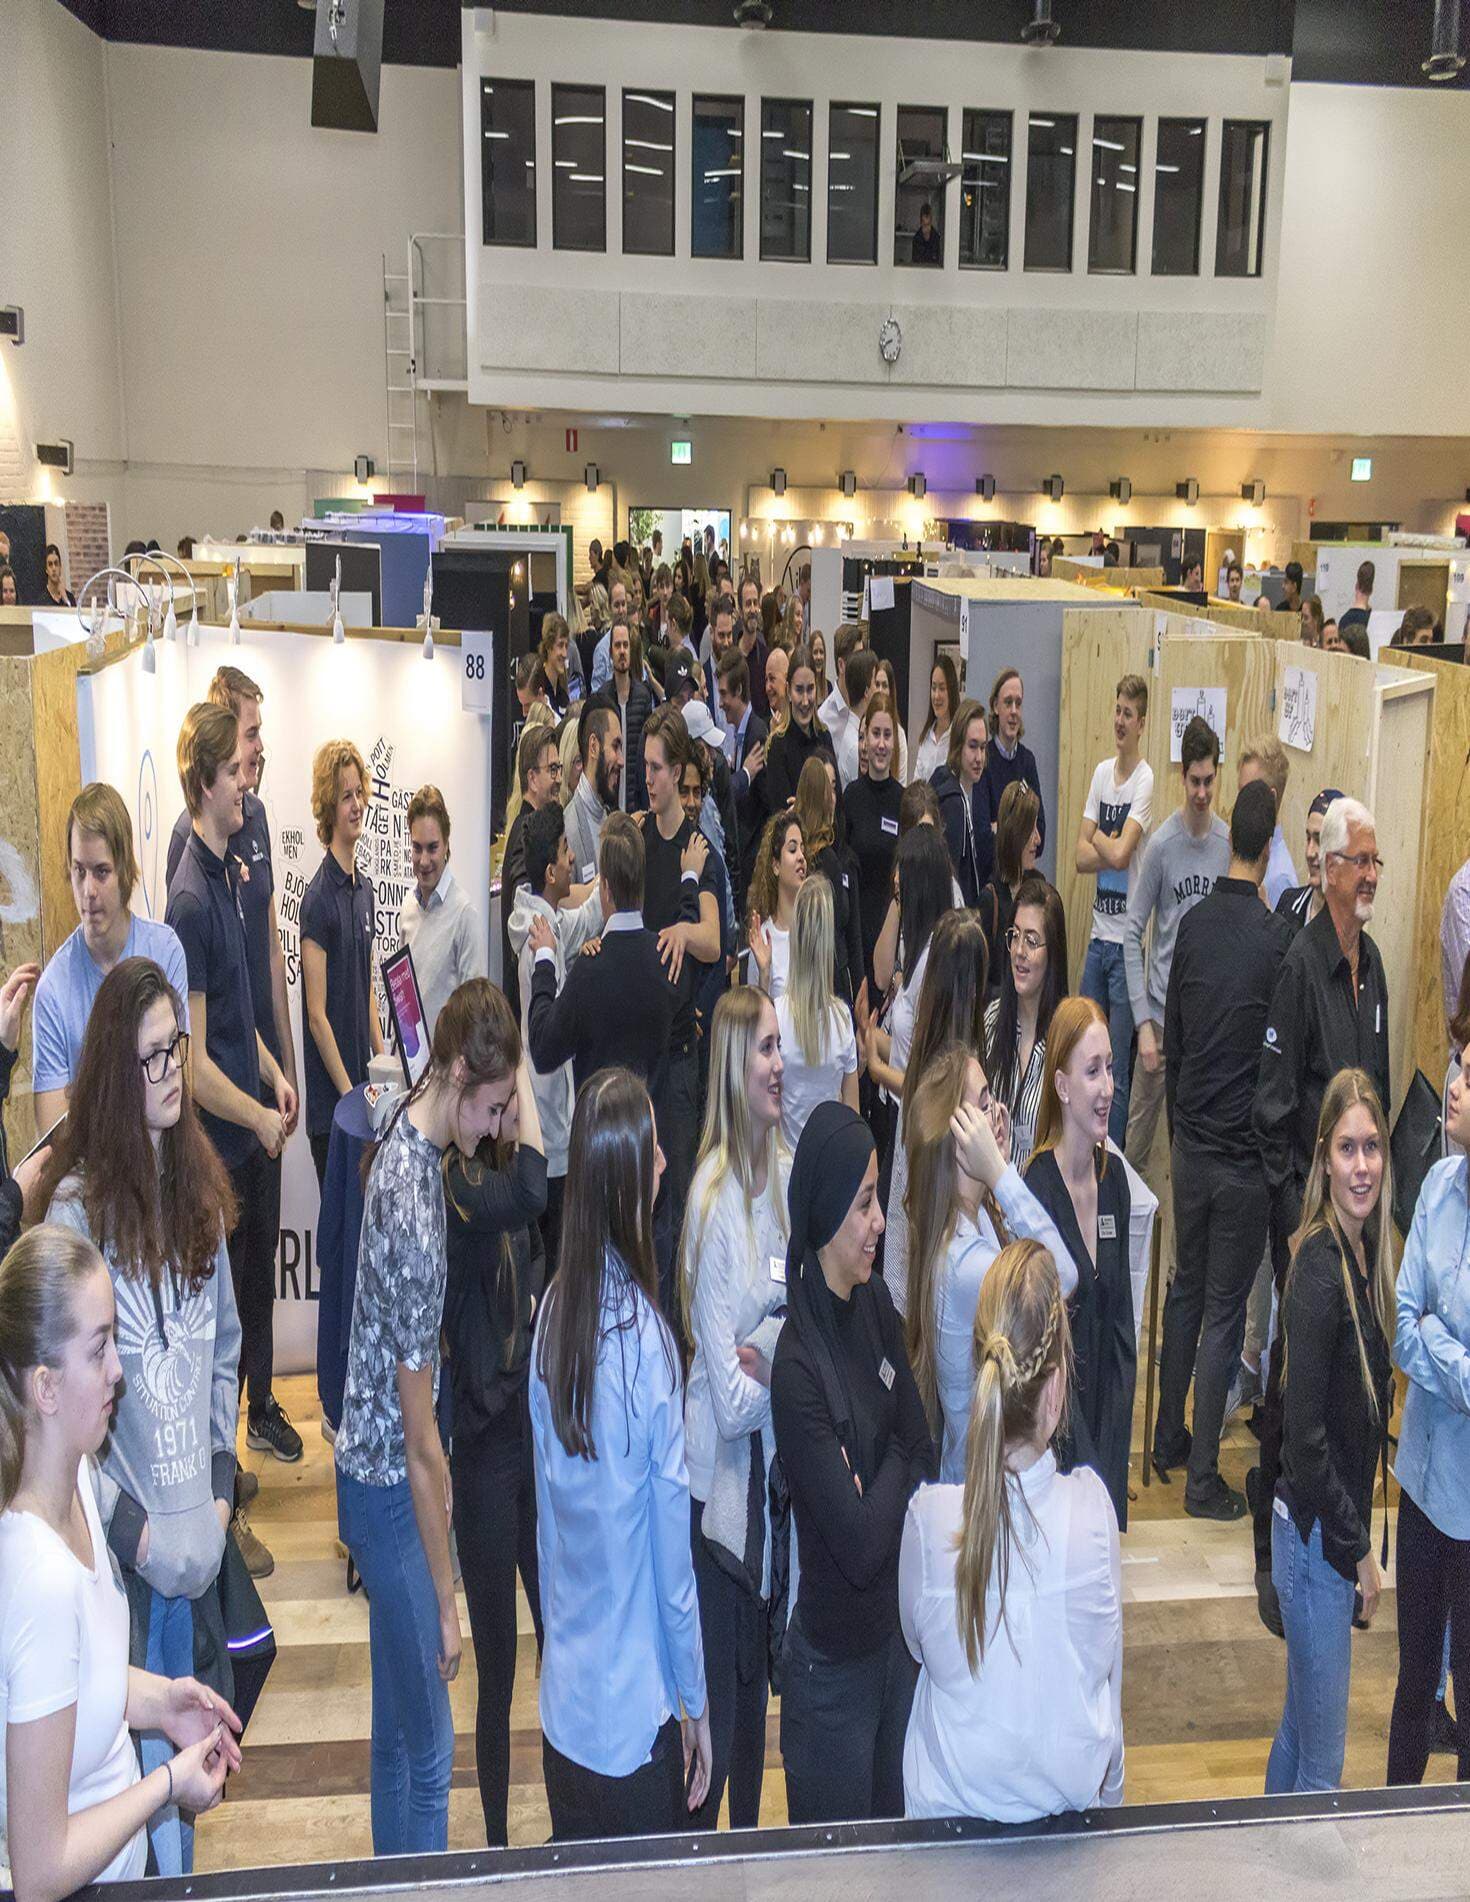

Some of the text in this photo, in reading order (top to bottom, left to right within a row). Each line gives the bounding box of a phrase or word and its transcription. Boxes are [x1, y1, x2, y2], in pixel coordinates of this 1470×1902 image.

[466, 654, 485, 680] 88
[281, 831, 304, 845] EKHOL
[283, 844, 298, 859] MEN
[380, 839, 392, 857] PA
[380, 858, 392, 876] RK
[154, 1416, 198, 1458] 1971
[150, 1453, 198, 1487] FRANK
